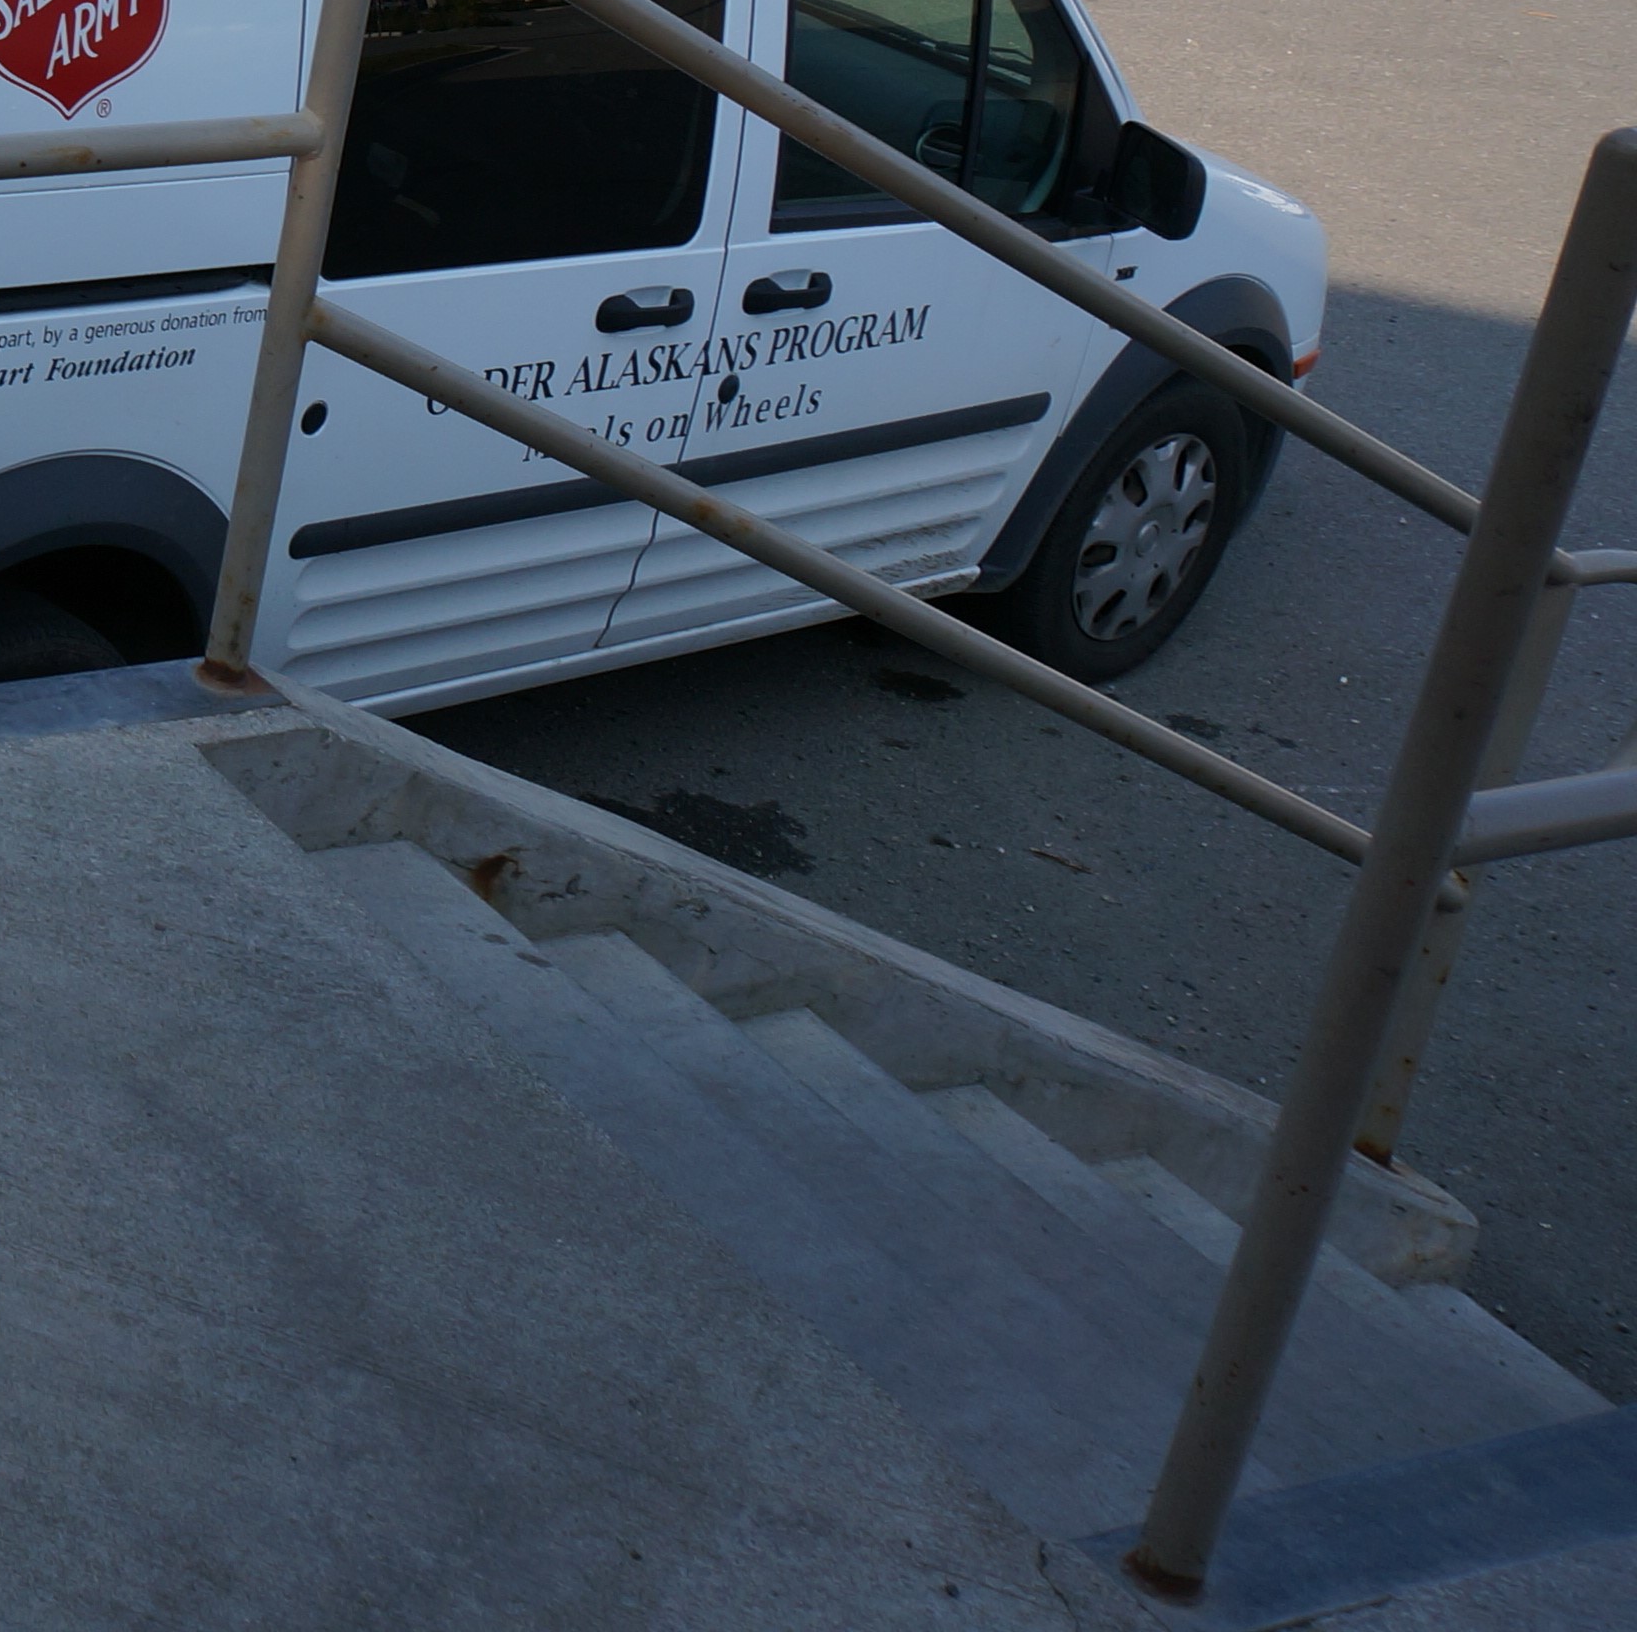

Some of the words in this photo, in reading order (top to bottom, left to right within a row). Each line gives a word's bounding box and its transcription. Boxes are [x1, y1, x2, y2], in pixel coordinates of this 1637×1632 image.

[43, 325, 62, 348] by
[69, 327, 78, 342] a
[84, 317, 155, 344] generous
[161, 308, 227, 332] donation
[233, 305, 267, 324] from
[564, 331, 761, 396] ALASKANS
[765, 304, 931, 366] PROGRAM
[45, 345, 196, 382] Foundation
[646, 412, 689, 443] on
[705, 383, 822, 433] Wheels
